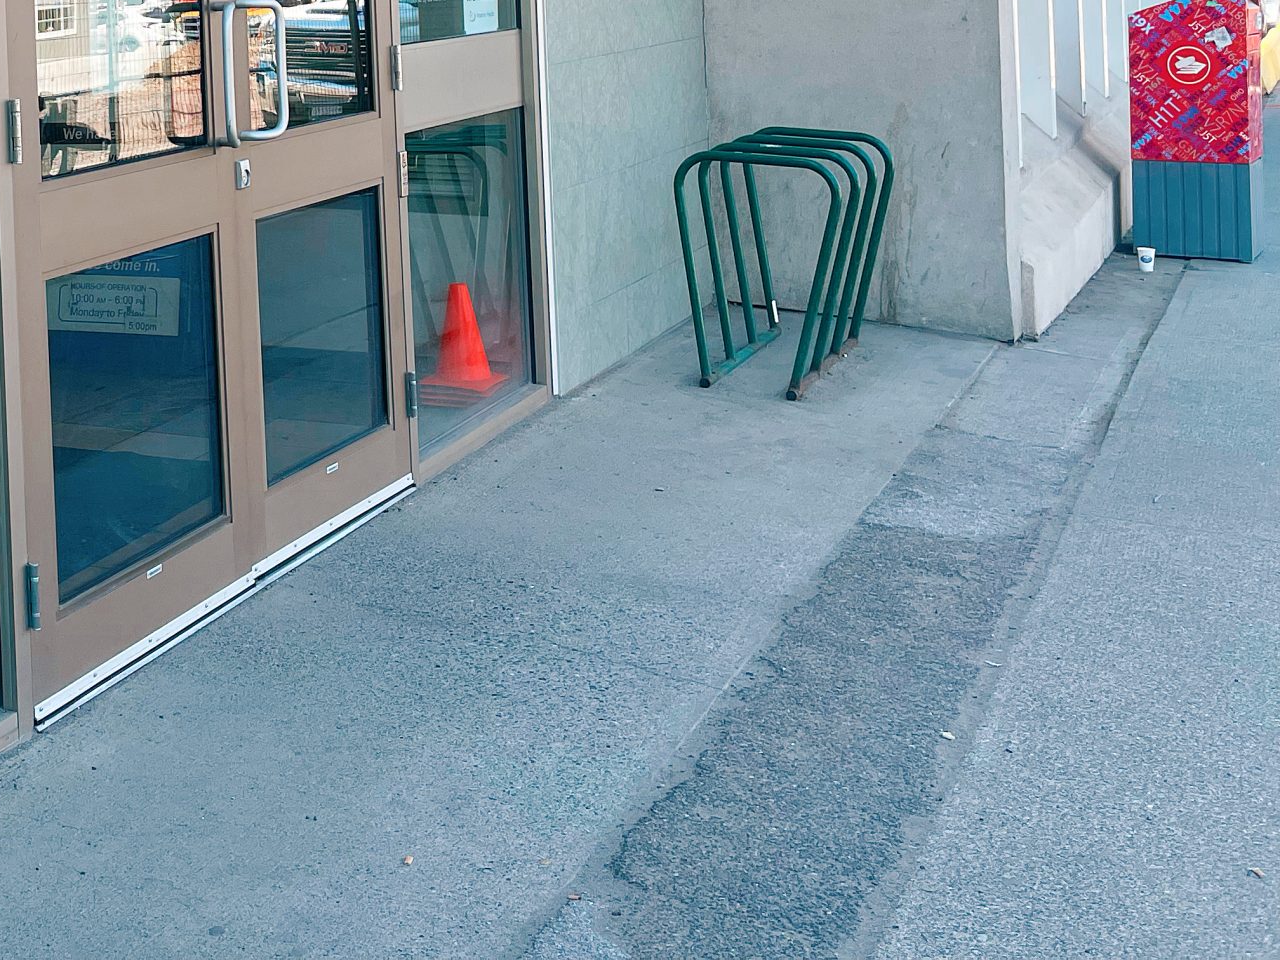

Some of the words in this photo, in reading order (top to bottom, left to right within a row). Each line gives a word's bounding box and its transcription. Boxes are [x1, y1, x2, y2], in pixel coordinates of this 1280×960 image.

[1148, 97, 1181, 128] H1T
[63, 127, 84, 140] We
[105, 259, 142, 271] come
[144, 259, 160, 273] in.
